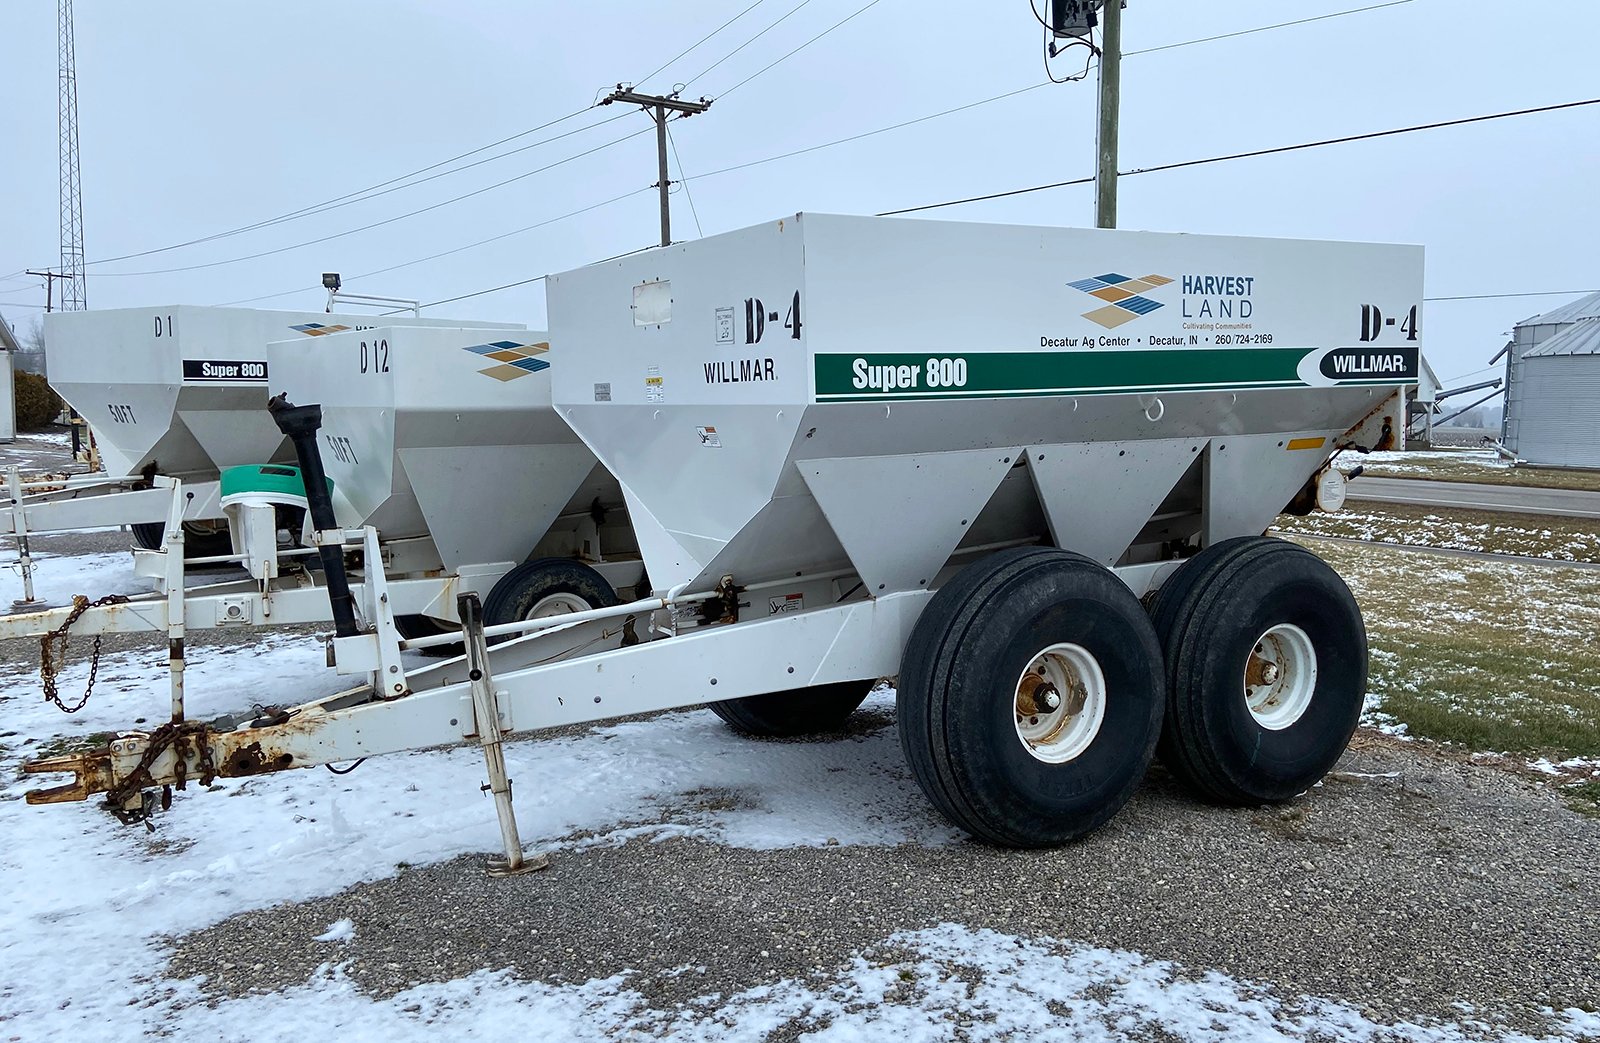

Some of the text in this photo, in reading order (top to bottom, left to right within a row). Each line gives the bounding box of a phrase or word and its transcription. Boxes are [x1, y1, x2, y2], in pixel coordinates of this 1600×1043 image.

[1182, 275, 1254, 296] HARVEST
[744, 289, 803, 344] D-4
[1182, 298, 1252, 318] LAND
[1182, 322, 1252, 332] Cultivating Communities
[1359, 303, 1418, 342] D-4
[1040, 333, 1273, 349] Decatur Ag Center Decatur, IN 260/724-2169
[202, 362, 265, 378] Super 800
[852, 358, 967, 393] Super 800
